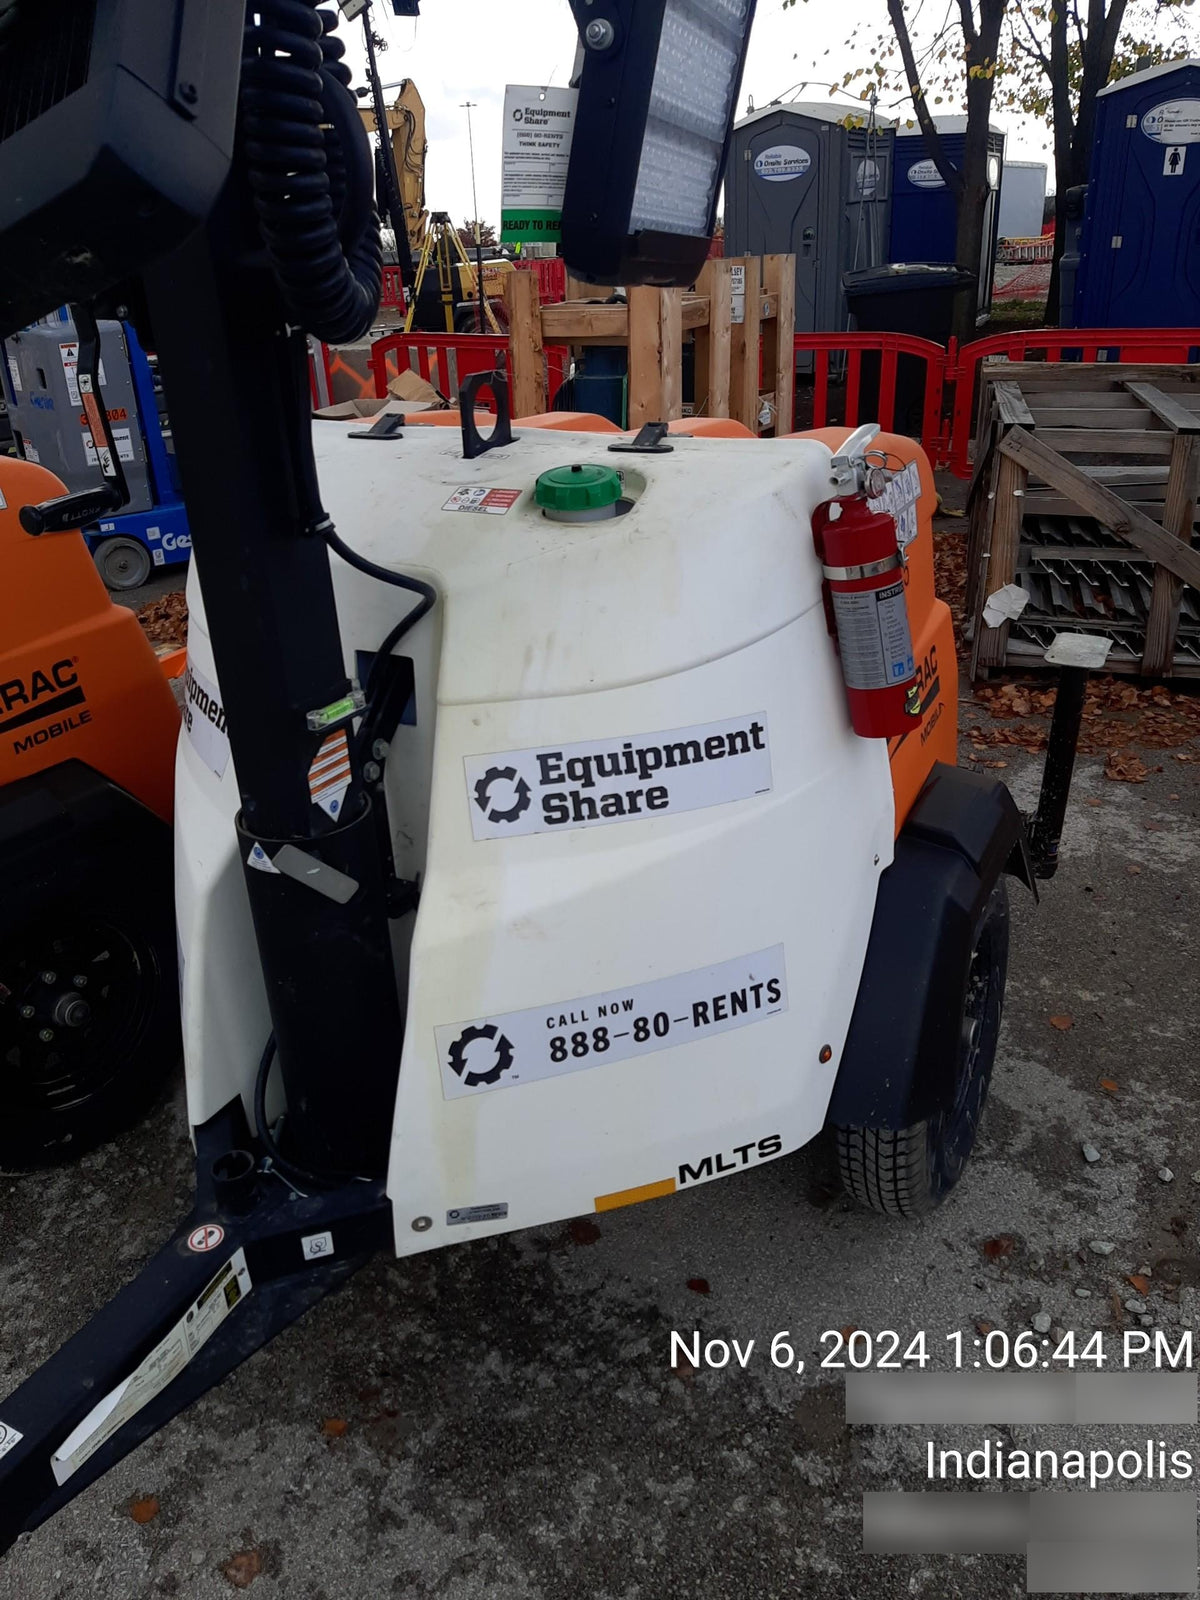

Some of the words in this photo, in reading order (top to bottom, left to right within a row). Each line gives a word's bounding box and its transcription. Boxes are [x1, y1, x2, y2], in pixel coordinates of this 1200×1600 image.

[524, 106, 571, 118] Equipment
[524, 117, 549, 125] Share
[503, 220, 531, 231] READY
[532, 220, 543, 231] TO
[458, 504, 488, 512] DIESEL
[0, 658, 79, 714] RAC
[13, 709, 93, 755] MOBILE
[536, 721, 766, 788] Equipment
[541, 785, 670, 826] Share
[546, 1010, 589, 1030] CALL
[598, 998, 635, 1018] NOW
[549, 977, 782, 1063] 888-80-RENTS
[678, 1133, 783, 1185] MLTS
